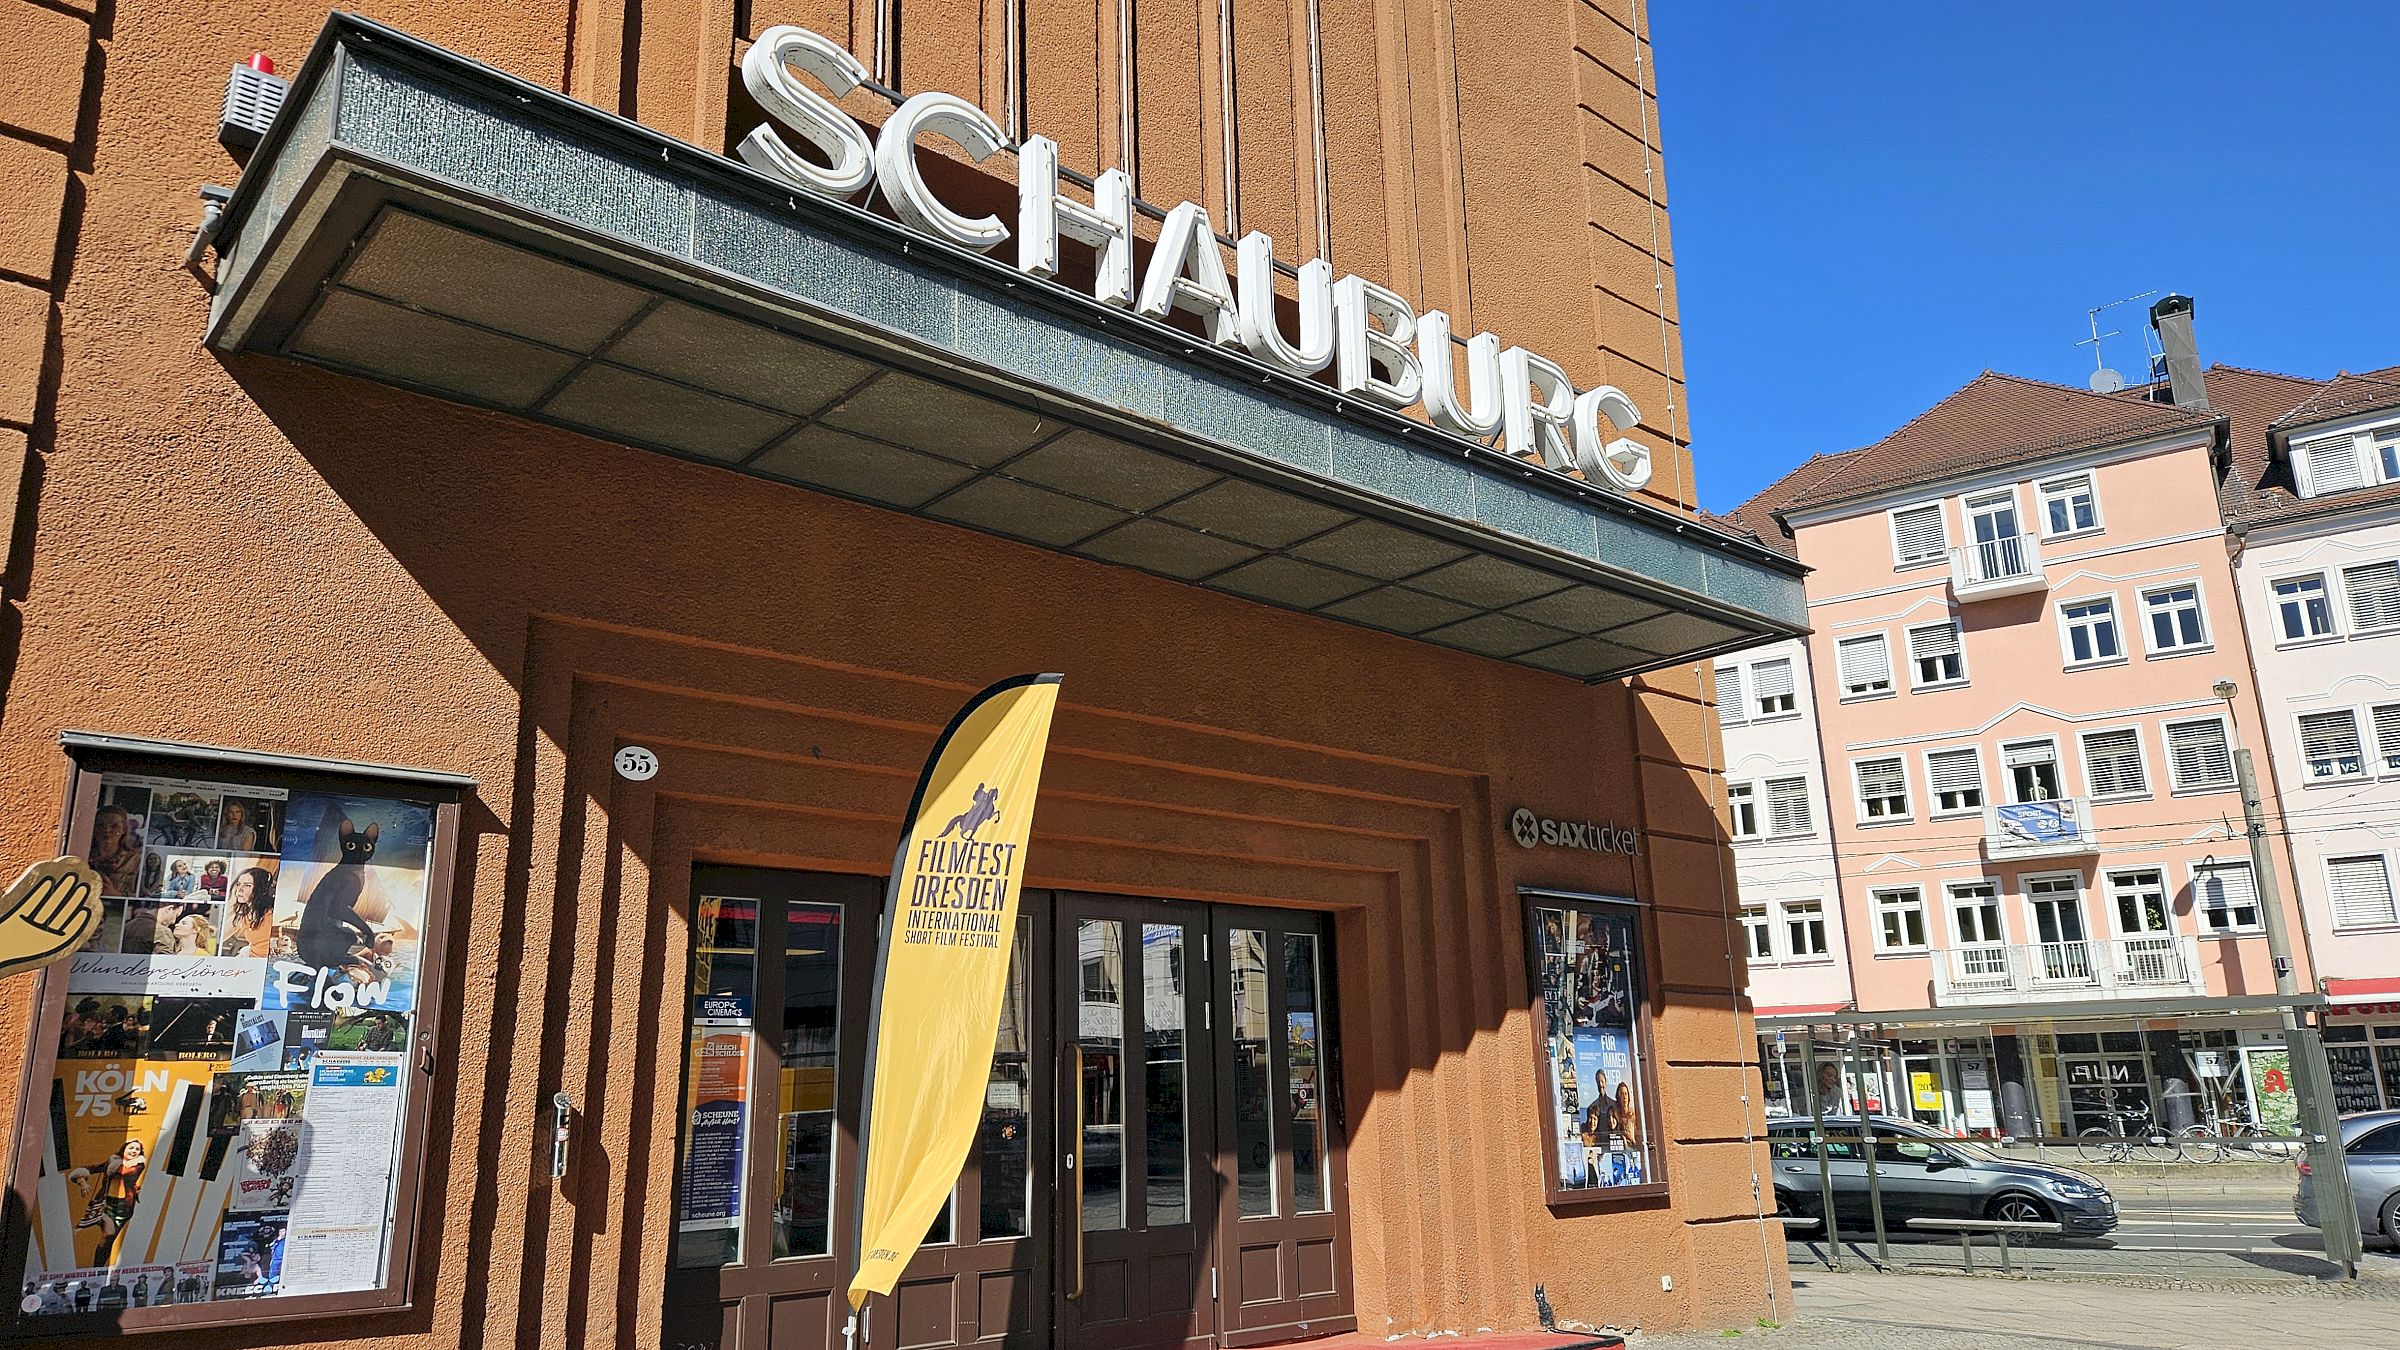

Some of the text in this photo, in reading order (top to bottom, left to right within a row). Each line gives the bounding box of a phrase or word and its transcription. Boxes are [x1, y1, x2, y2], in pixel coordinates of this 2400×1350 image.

[736, 24, 1652, 493] SCHAUBURG
[622, 753, 651, 774] 55
[1541, 819, 1642, 856] SAXticket
[918, 840, 1016, 876] FILMFEST
[911, 875, 1008, 911] DRESDEN
[908, 910, 1000, 932] INTERNATIONAL
[905, 930, 999, 948] SHORT FILM FESTIVAL
[71, 957, 252, 979] Wunderschöner
[273, 960, 390, 1011] Flow
[704, 1001, 736, 1009] EUROPA
[707, 1008, 742, 1016] CINEMAS
[1600, 1033, 1616, 1051] FÜR
[178, 1051, 216, 1059] BOLERO
[1603, 1052, 1626, 1068] IMMER
[2206, 1056, 2219, 1065] 57
[1967, 1062, 1979, 1070] 57
[75, 1063, 169, 1093] KÖLN
[1605, 1070, 1621, 1085] HIER
[74, 1095, 112, 1117] 75
[703, 1110, 739, 1118] SCHEUNE
[692, 1210, 726, 1219] scheune.org
